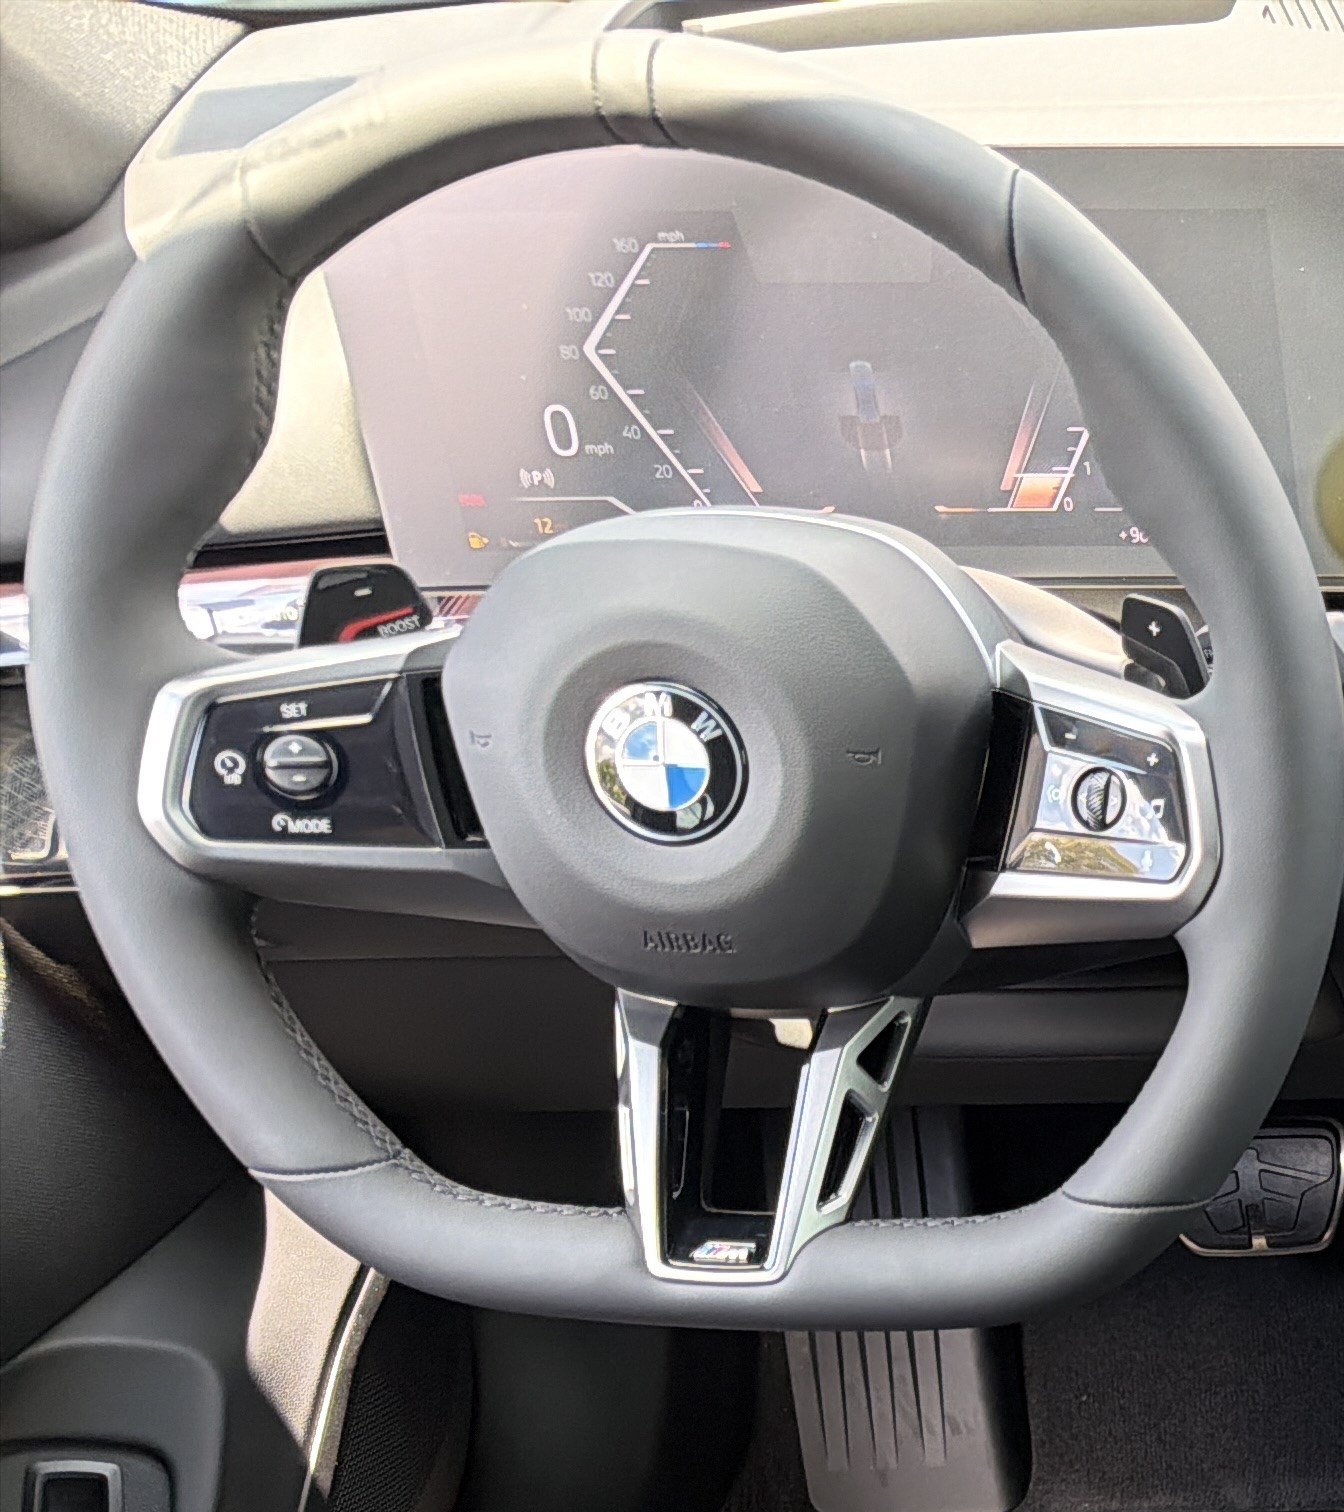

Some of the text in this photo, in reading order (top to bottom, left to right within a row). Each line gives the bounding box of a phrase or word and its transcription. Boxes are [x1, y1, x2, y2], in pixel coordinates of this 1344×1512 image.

[657, 230, 685, 243] mph
[612, 237, 639, 253] 160
[588, 271, 614, 288] 120
[565, 306, 592, 322] 100
[559, 344, 579, 360] 80
[589, 385, 609, 400] 60
[543, 404, 615, 457] 0 mph
[622, 425, 641, 440] 40
[654, 464, 673, 479] 20
[1083, 461, 1091, 476] 1
[1063, 496, 1074, 512] 0
[377, 614, 420, 638] BOOST
[280, 702, 308, 718] SET
[601, 691, 724, 743] BMW
[288, 817, 333, 834] MODE
[642, 929, 735, 953] AIRBAG
